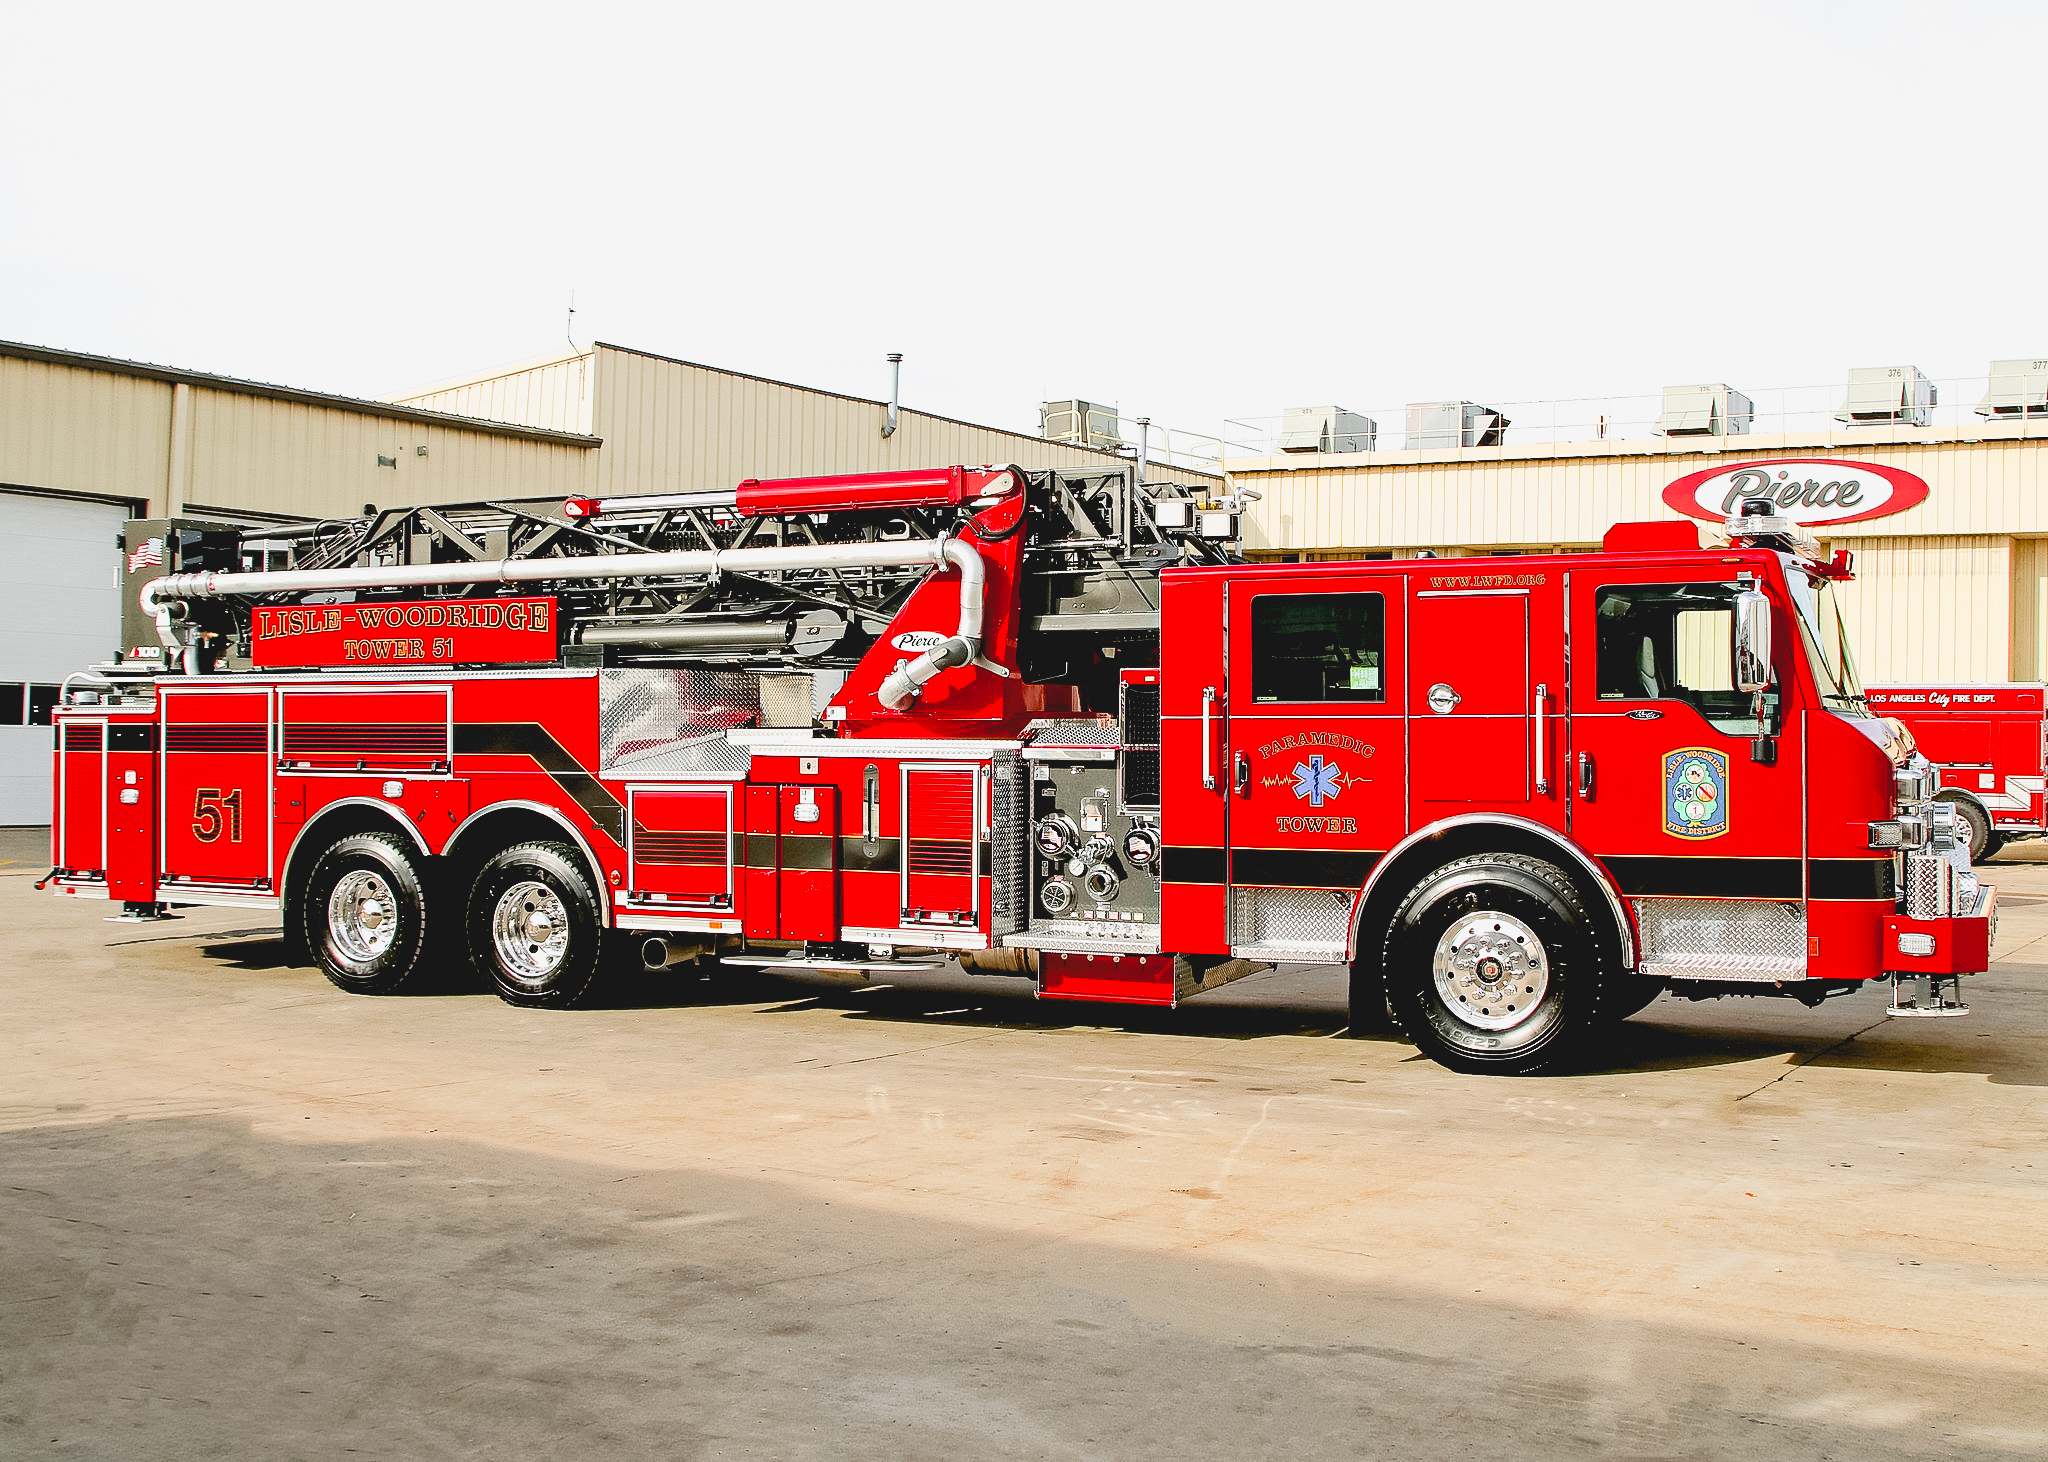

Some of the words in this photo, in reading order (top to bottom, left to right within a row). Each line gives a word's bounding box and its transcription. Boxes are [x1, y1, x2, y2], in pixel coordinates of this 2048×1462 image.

[1887, 368, 1902, 378] 376
[2032, 360, 2048, 370] 377
[1721, 469, 1864, 514] Pierce
[1430, 573, 1547, 588] WWW.LWFD.ORG
[259, 602, 549, 640] LISLE-WOODRIDGE
[344, 638, 425, 660] TOWER
[432, 637, 454, 659] 51
[898, 633, 940, 649] Pierce
[1870, 694, 1887, 703] LOS
[1889, 694, 1926, 703] ANGELES
[1928, 692, 1951, 708] City
[1952, 694, 1971, 703] FIRE
[1973, 694, 1996, 703] DEPT.
[1258, 731, 1376, 760] PARAMEDIC
[191, 787, 243, 843] 51
[1276, 816, 1358, 834] TOWER
[1666, 821, 1687, 833] FIRE
[1688, 822, 1726, 835] DISTRICT
